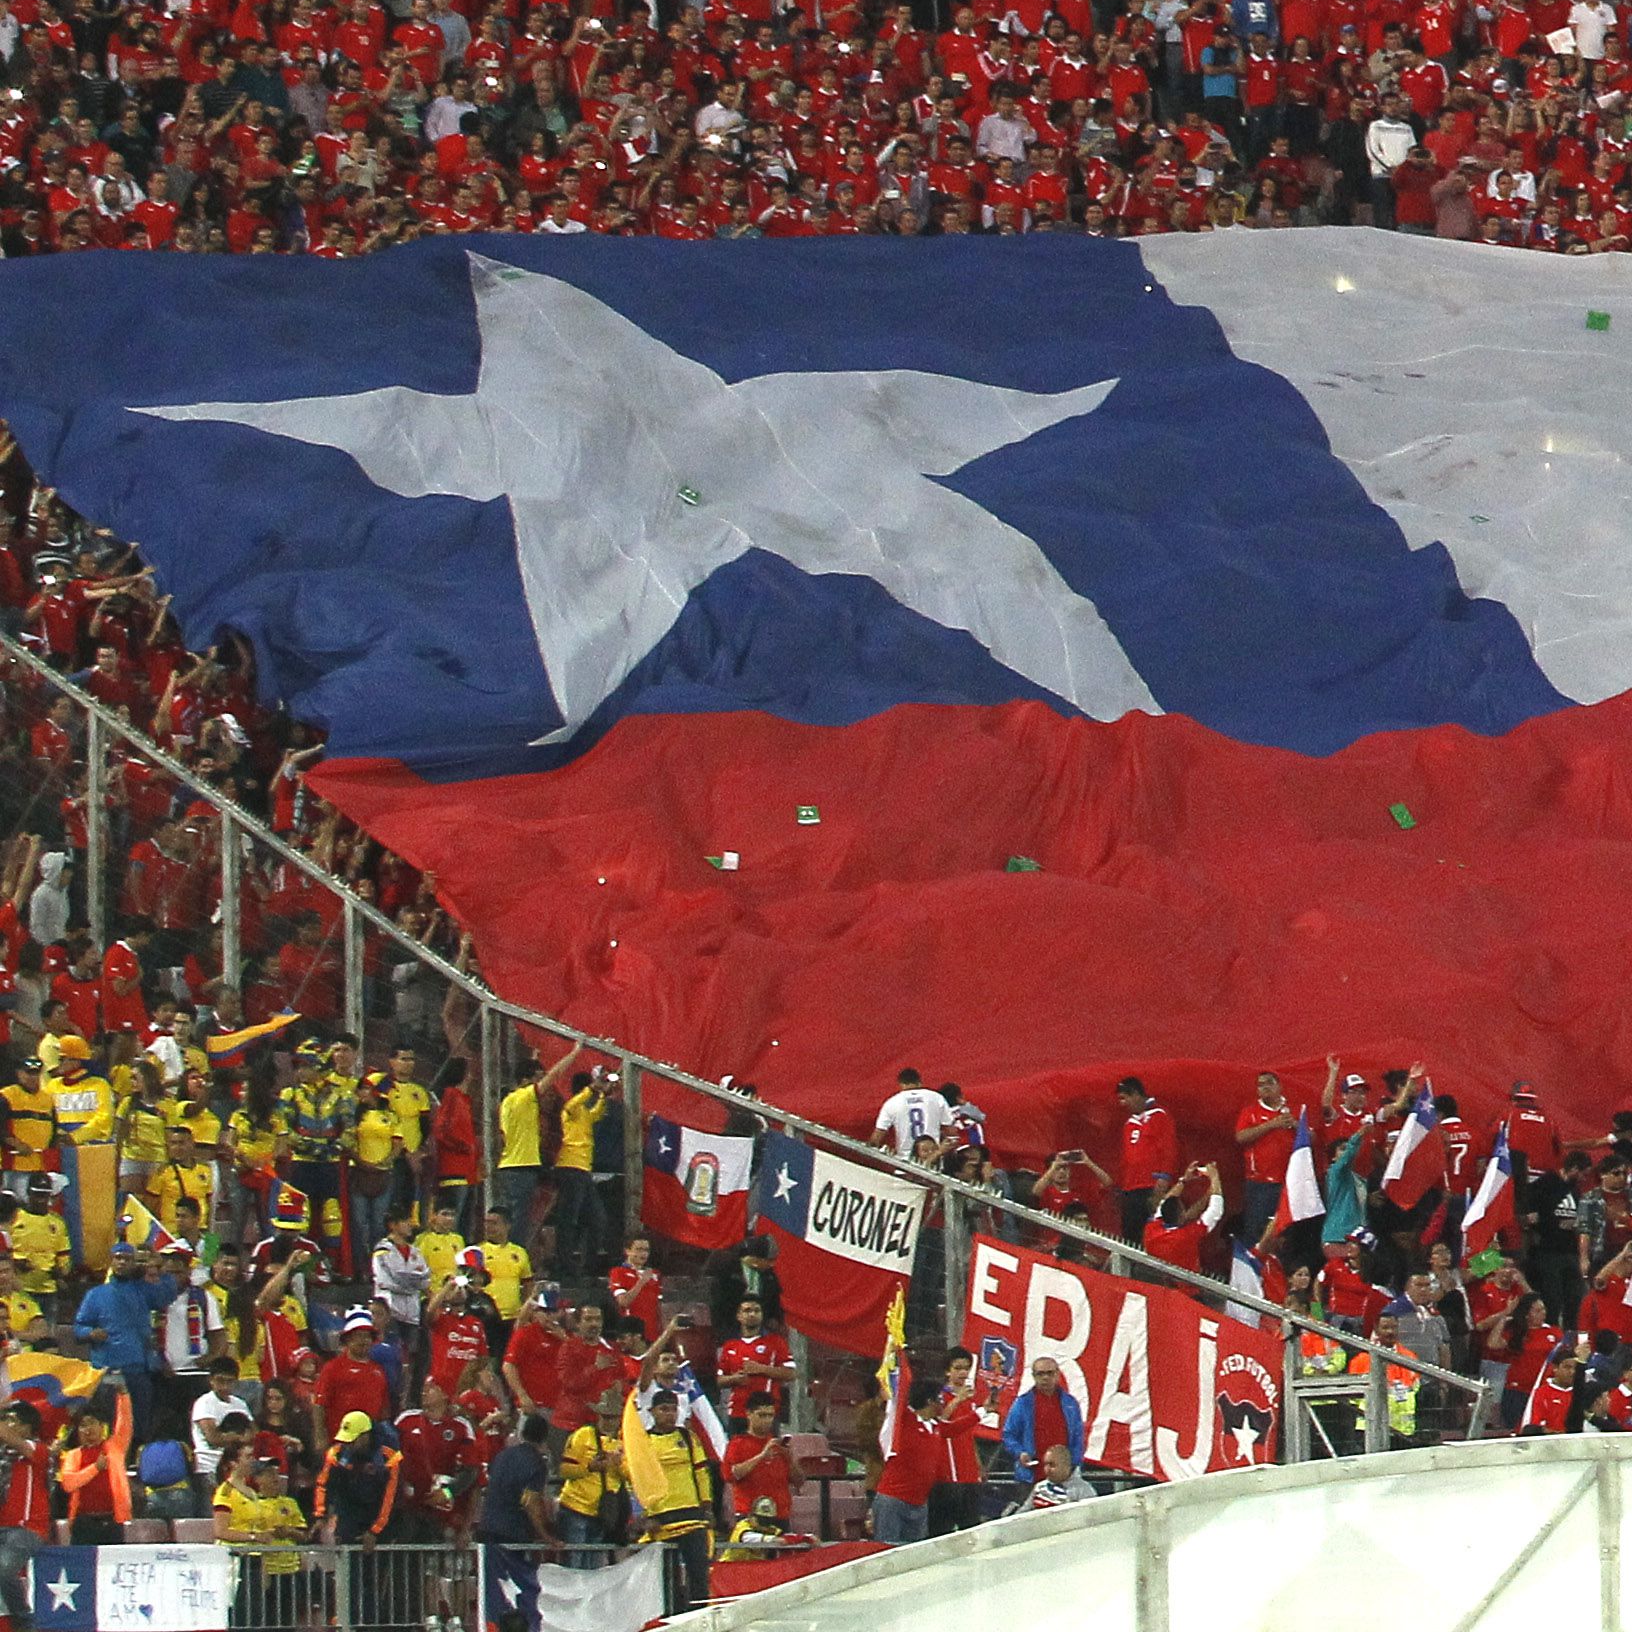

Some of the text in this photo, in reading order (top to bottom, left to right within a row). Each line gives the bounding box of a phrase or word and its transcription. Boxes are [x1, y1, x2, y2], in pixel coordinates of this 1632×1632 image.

[909, 1108, 925, 1139] 8
[1450, 1142, 1469, 1175] 7
[813, 1179, 918, 1258] CORONEL
